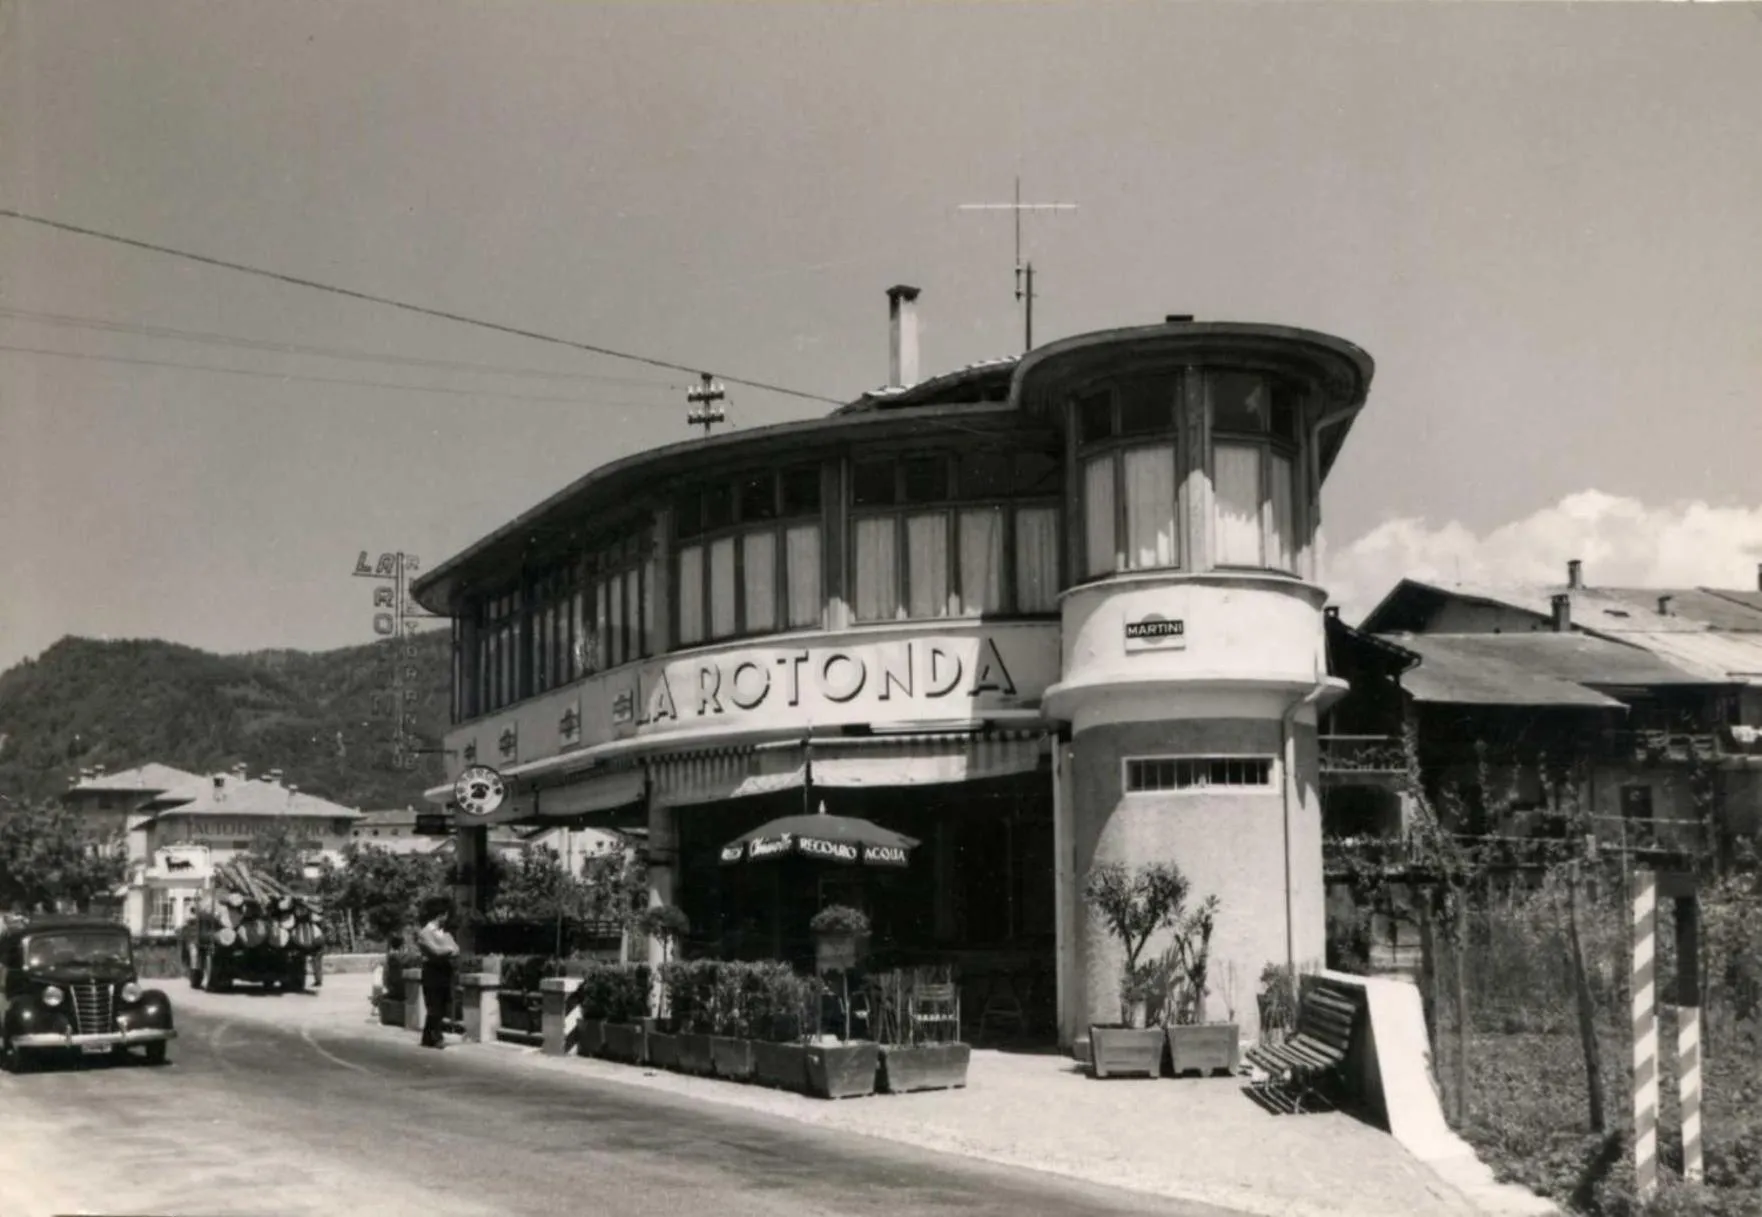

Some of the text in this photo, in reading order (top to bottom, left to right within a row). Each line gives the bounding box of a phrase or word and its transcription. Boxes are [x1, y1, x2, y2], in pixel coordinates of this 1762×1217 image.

[1128, 622, 1182, 636] MARTINI
[635, 636, 1017, 726] LA ROTONDA
[799, 837, 857, 860] RECOARO
[864, 847, 906, 862] ACQUA
